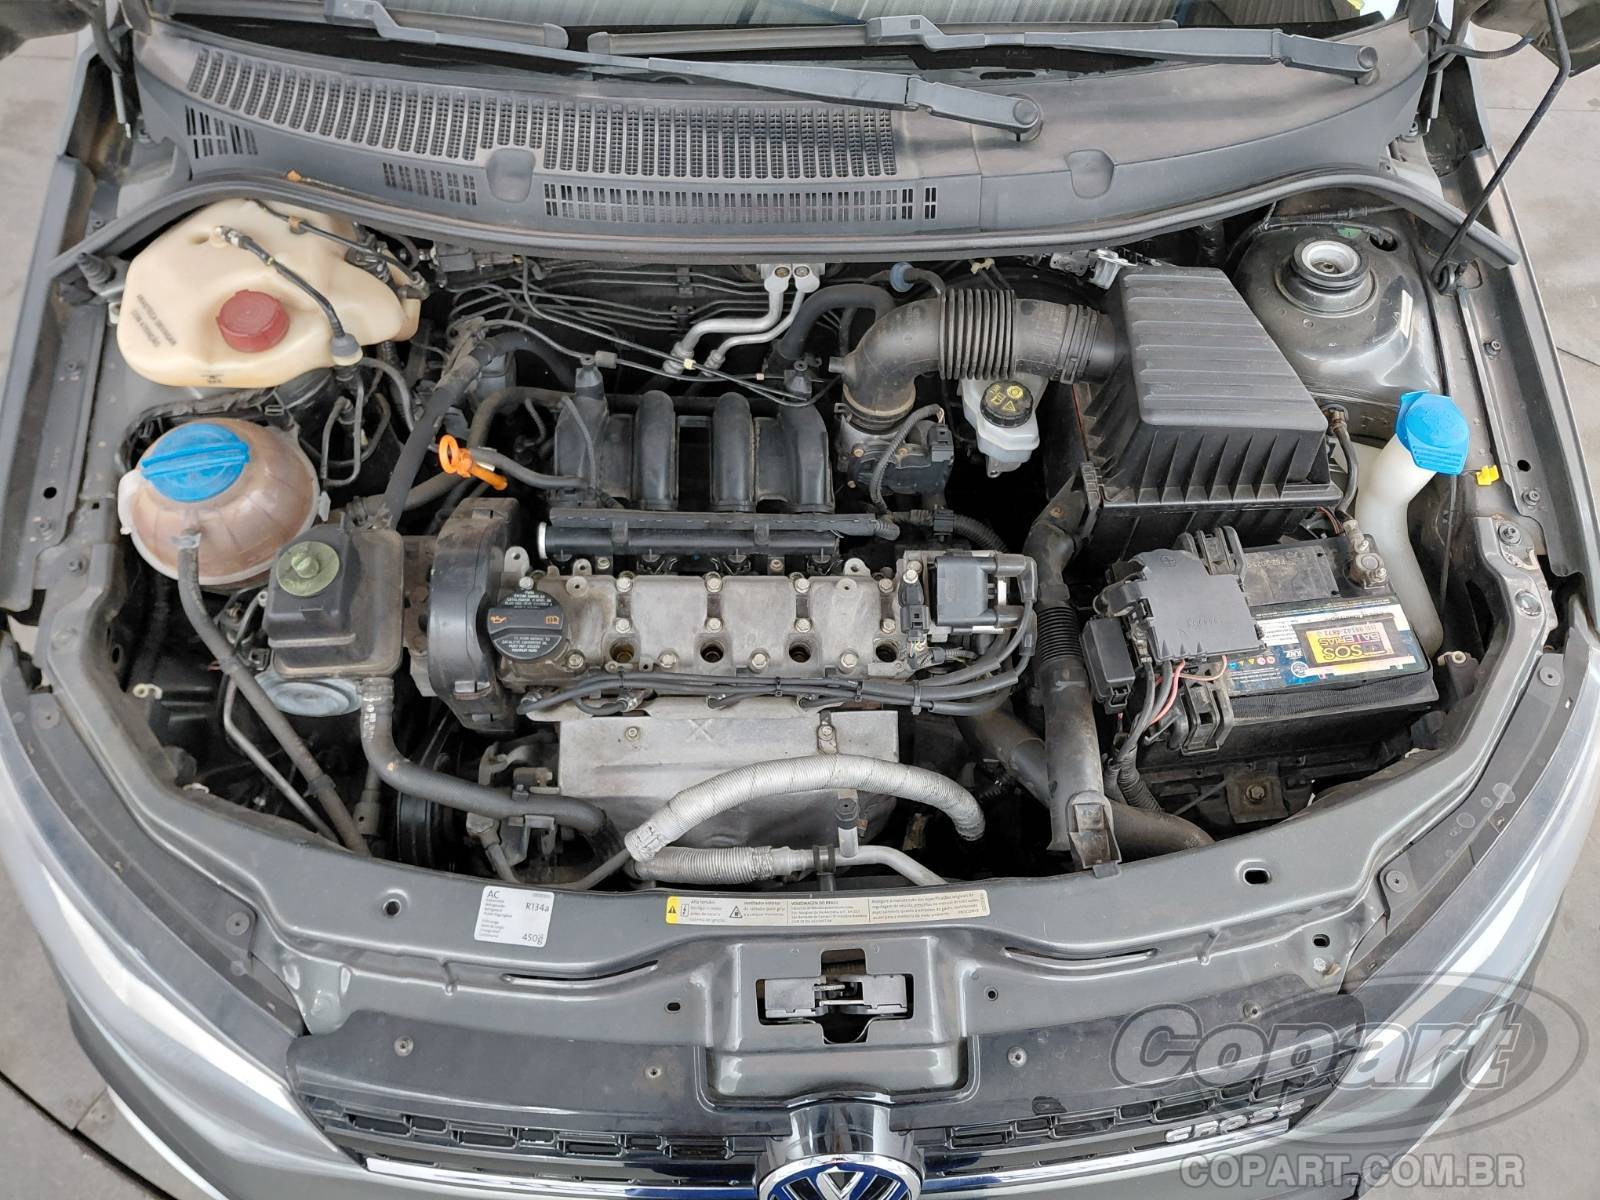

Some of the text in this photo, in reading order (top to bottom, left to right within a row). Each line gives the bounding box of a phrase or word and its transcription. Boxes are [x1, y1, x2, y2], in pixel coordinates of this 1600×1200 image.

[1323, 644, 1363, 660] SOS
[487, 889, 501, 899] AC
[525, 902, 550, 913] R134a
[522, 933, 544, 945] 450g
